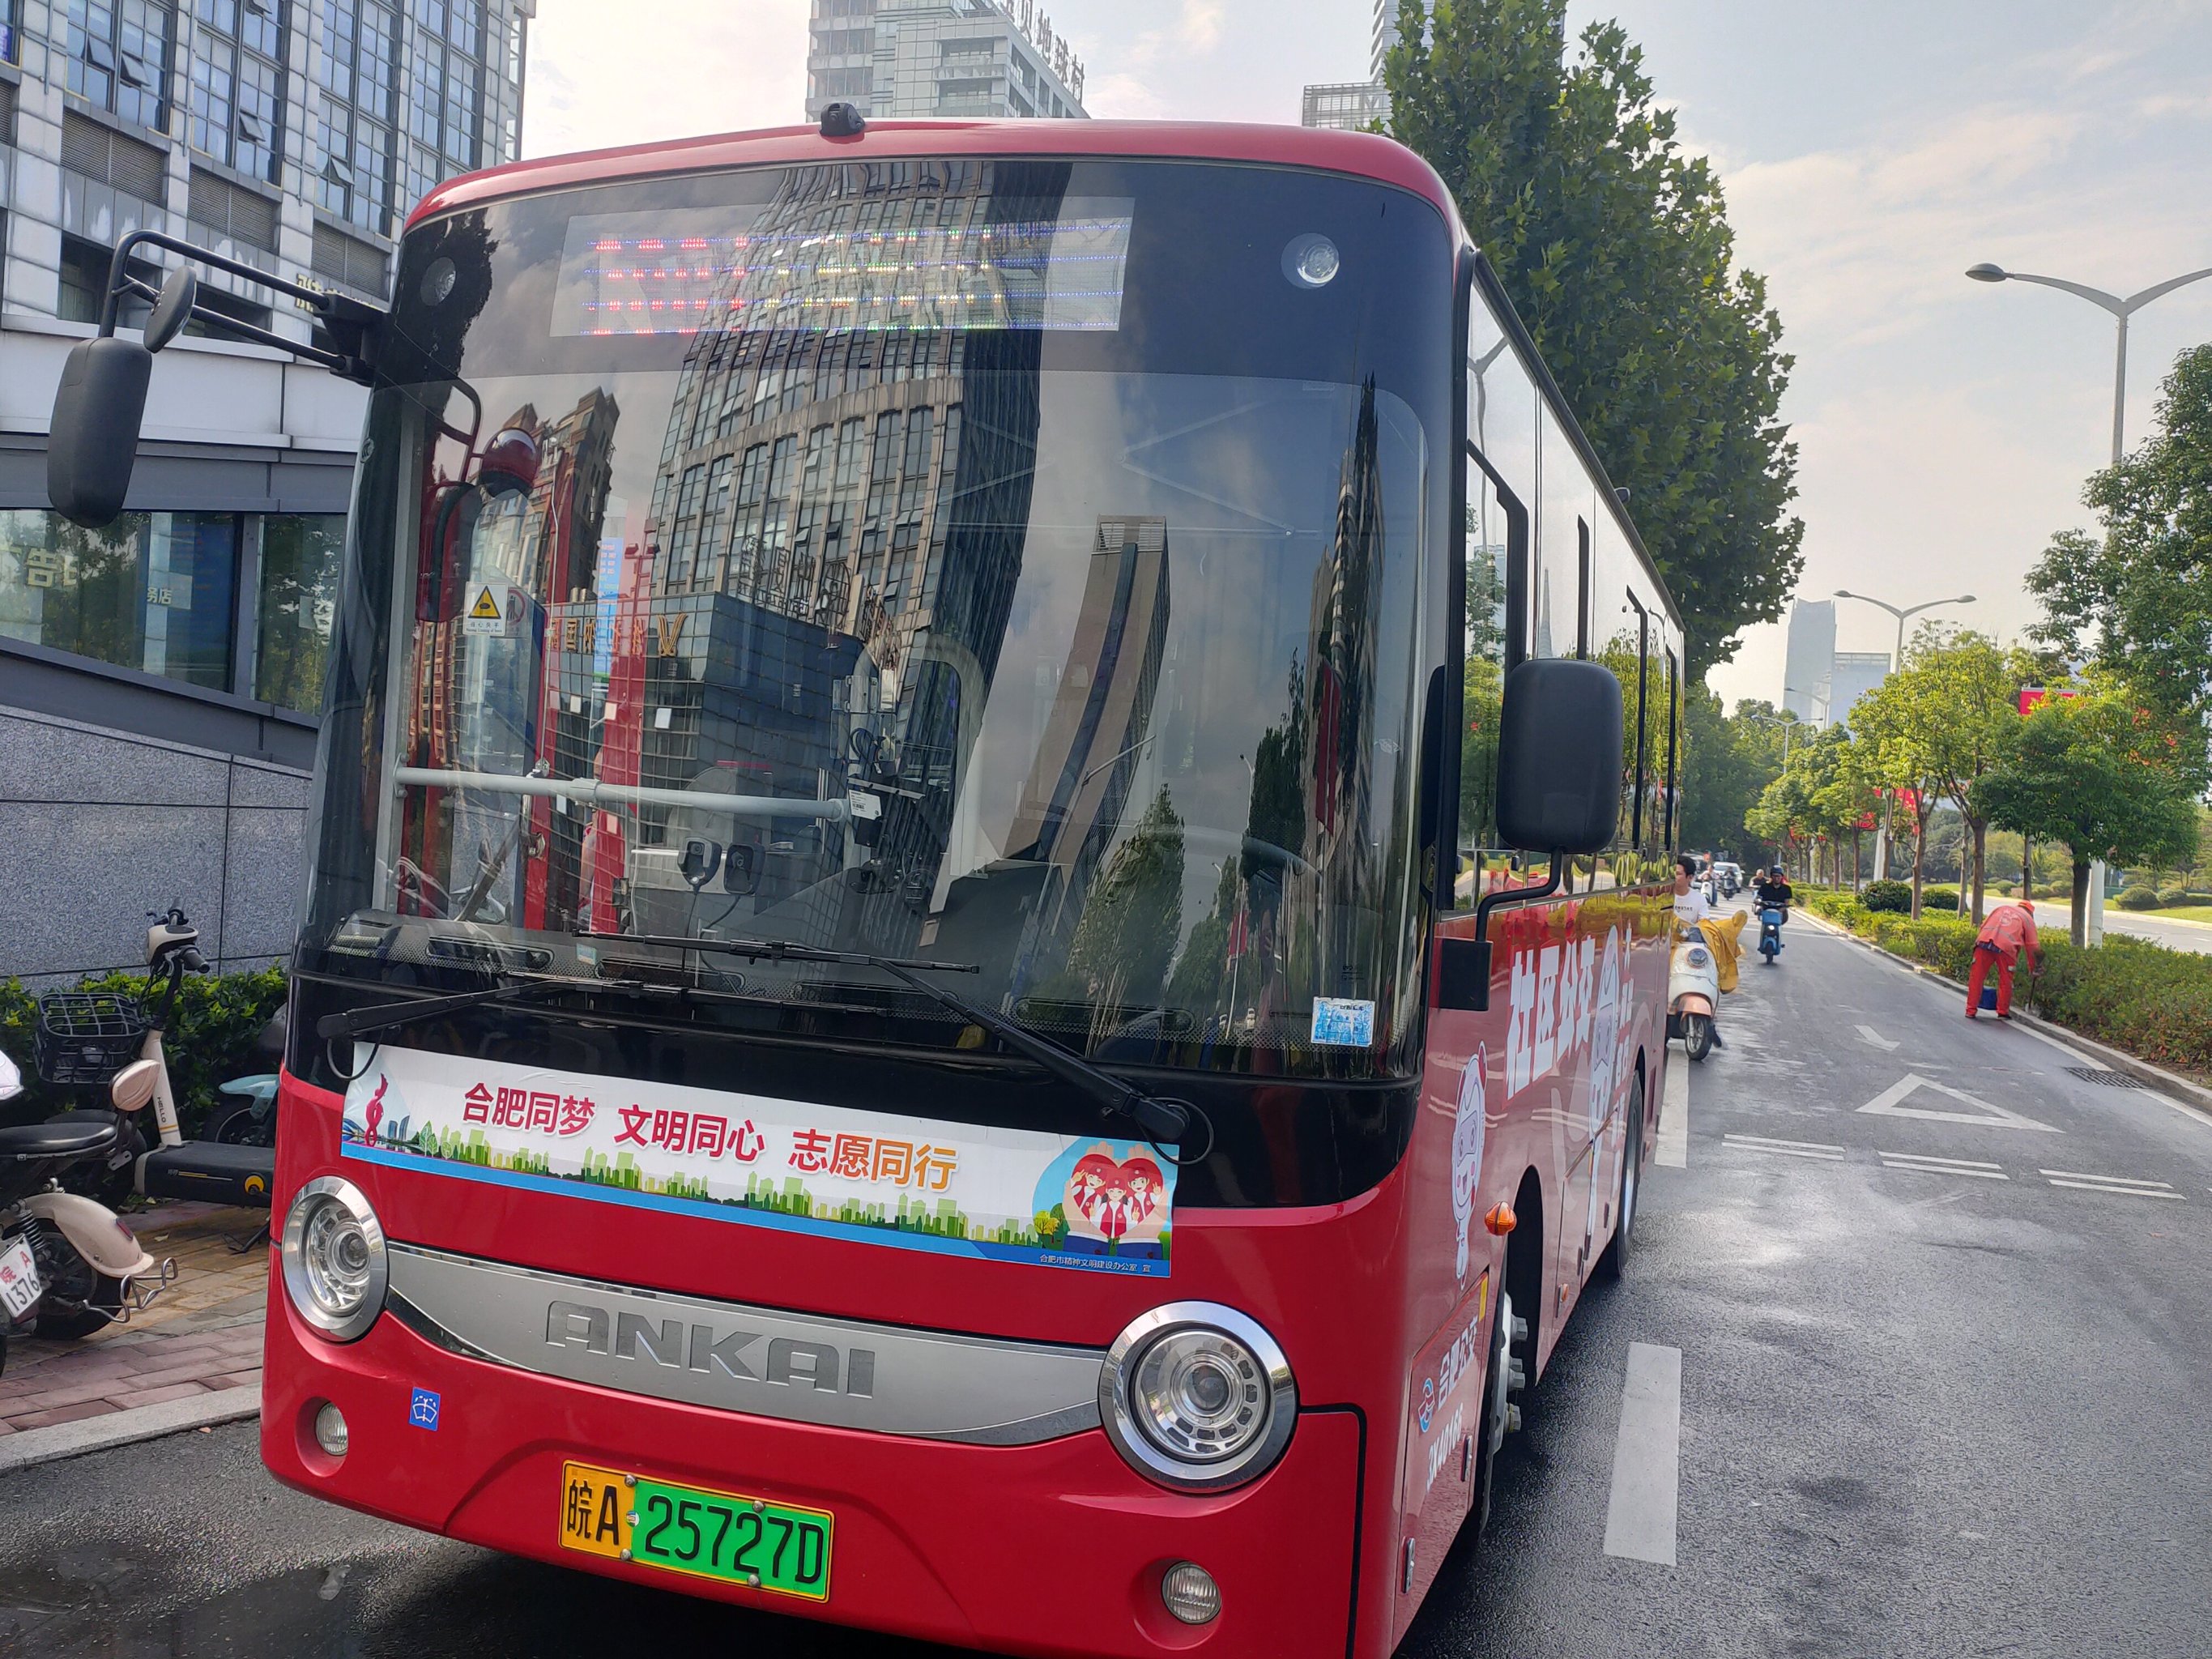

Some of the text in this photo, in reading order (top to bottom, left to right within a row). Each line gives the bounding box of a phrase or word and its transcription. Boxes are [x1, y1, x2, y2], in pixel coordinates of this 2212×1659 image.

[1507, 935, 1596, 1100] 社区公交
[462, 1083, 957, 1189] 合肥同梦 文明同心 志愿同行
[1039, 1254, 1137, 1272] 合肥市精神文明建设办公室
[545, 1300, 875, 1399] ANKAI
[1438, 1316, 1477, 1411] 合肥公交
